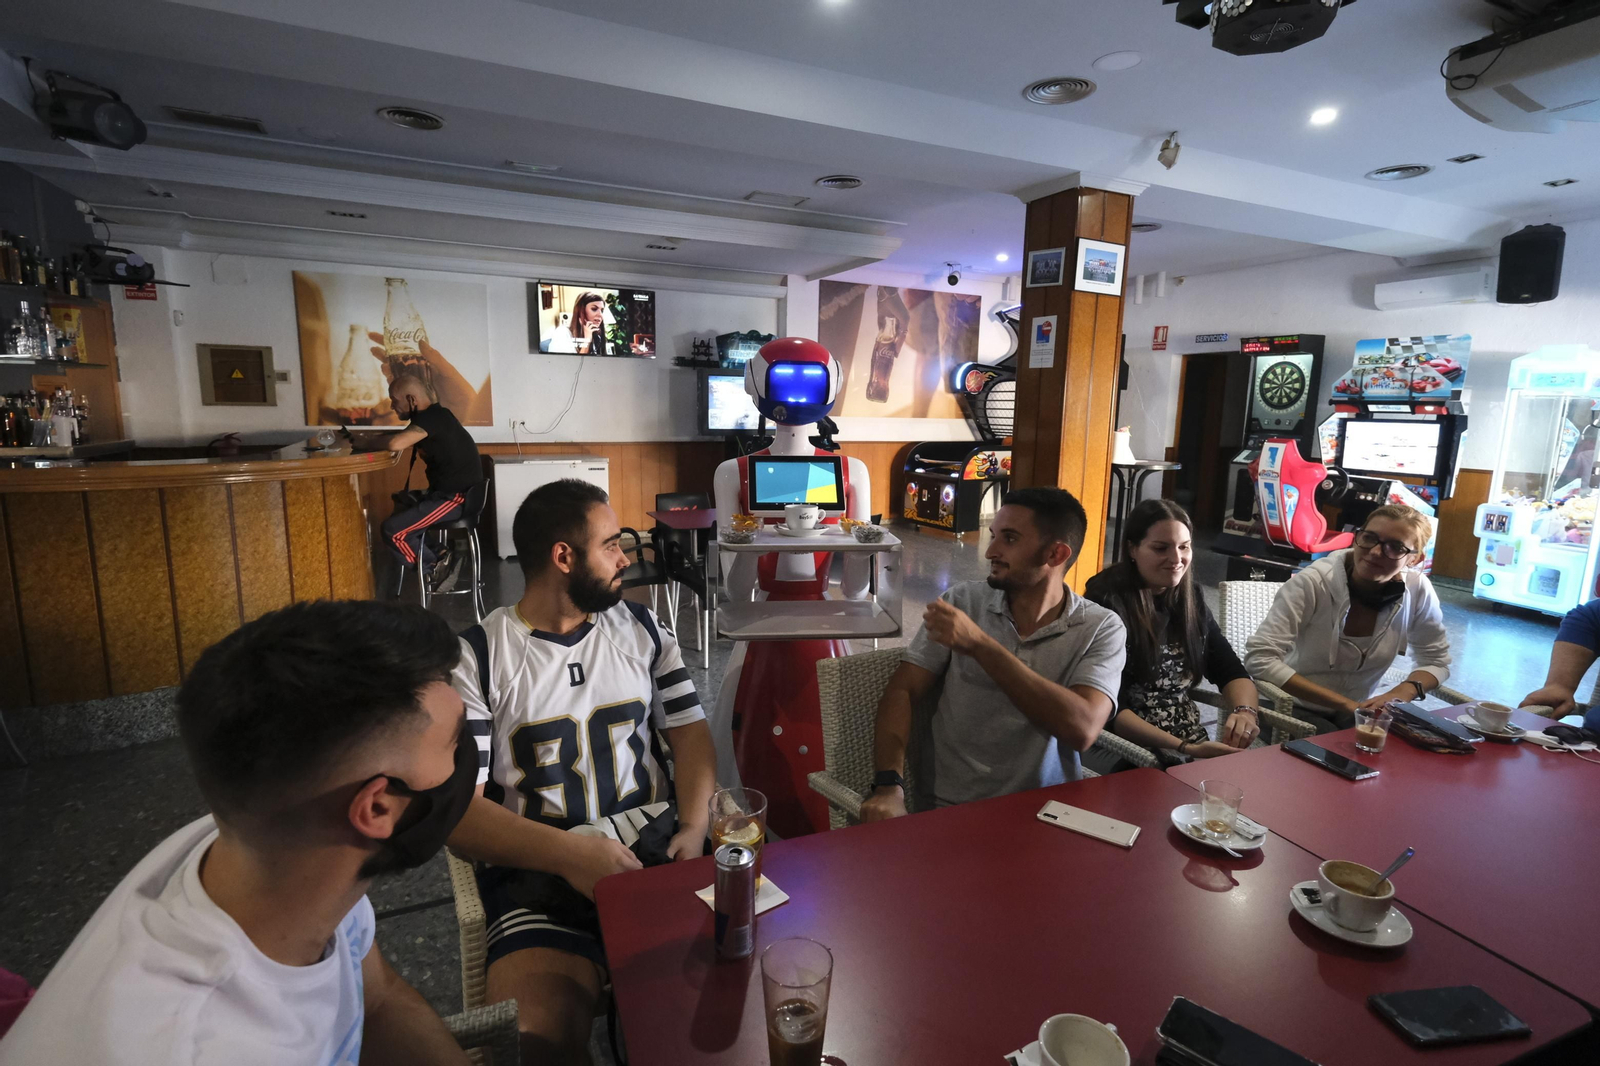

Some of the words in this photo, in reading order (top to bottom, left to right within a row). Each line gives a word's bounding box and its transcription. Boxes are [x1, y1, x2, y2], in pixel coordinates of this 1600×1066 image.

[1196, 334, 1228, 343] SERVICIOS
[567, 662, 586, 687] D
[508, 697, 656, 831] 80
